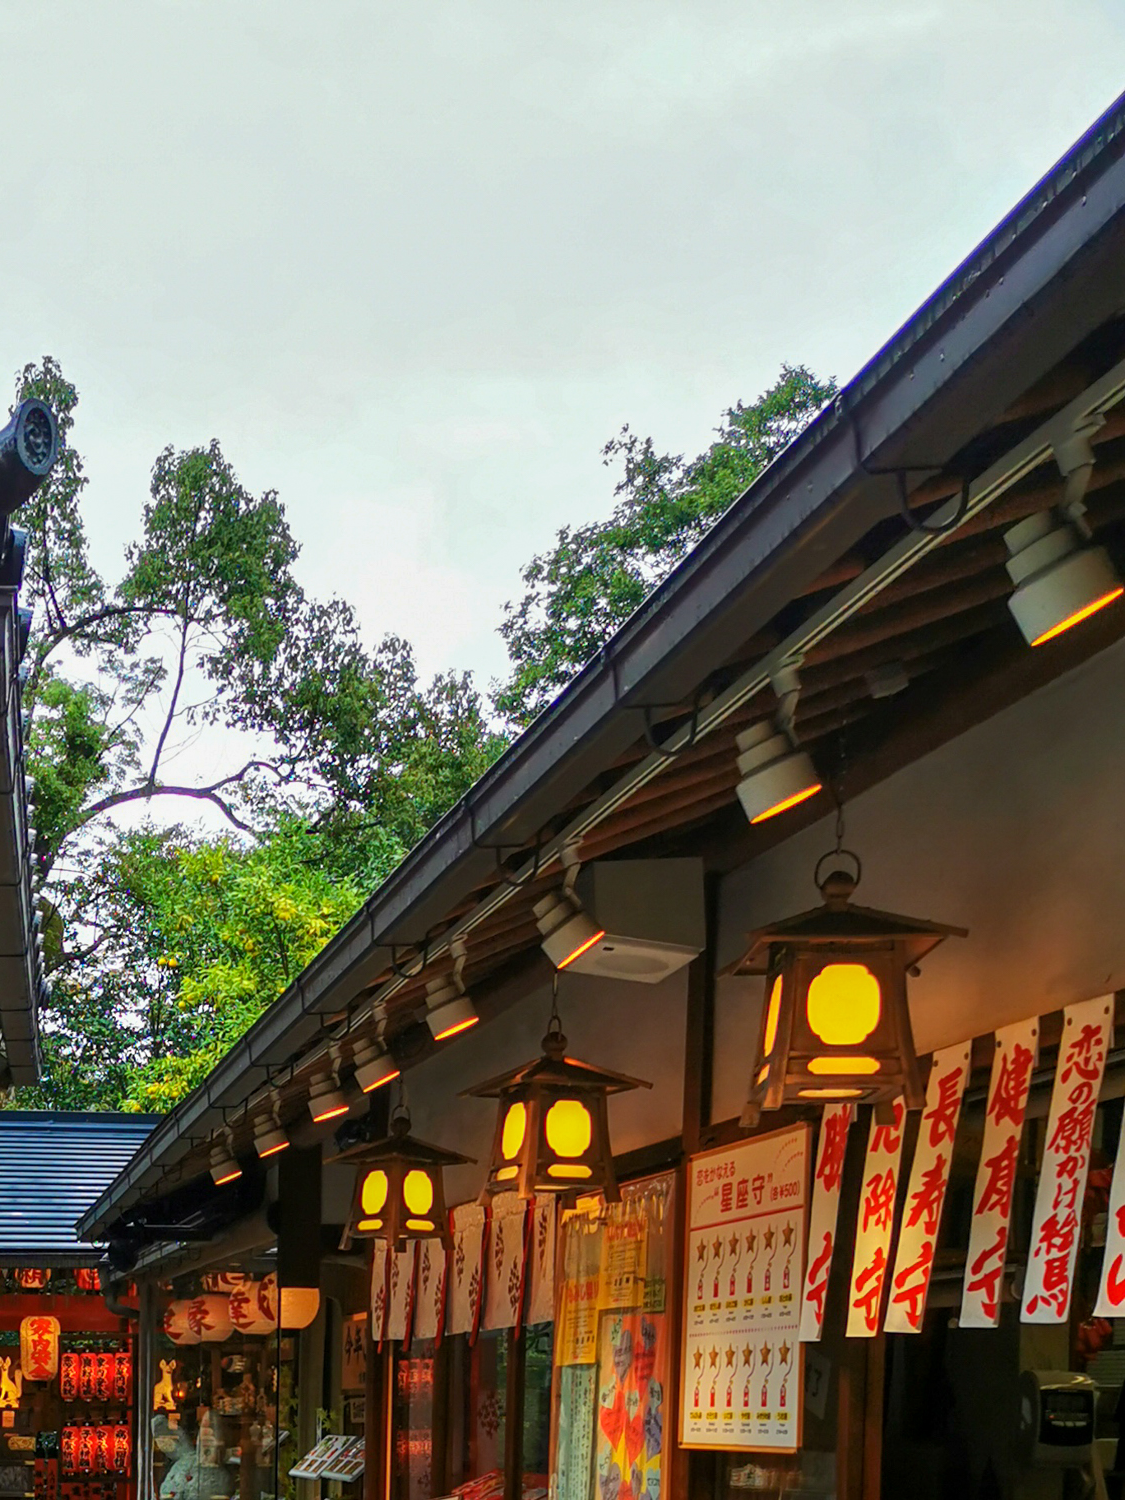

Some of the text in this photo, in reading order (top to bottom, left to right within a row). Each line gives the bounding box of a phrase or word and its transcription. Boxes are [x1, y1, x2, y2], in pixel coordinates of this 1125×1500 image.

[892, 1066, 962, 1329] 長寿守
[967, 1043, 1033, 1320] 健康守
[1025, 1024, 1104, 1318] 恋の願かけ絵馬
